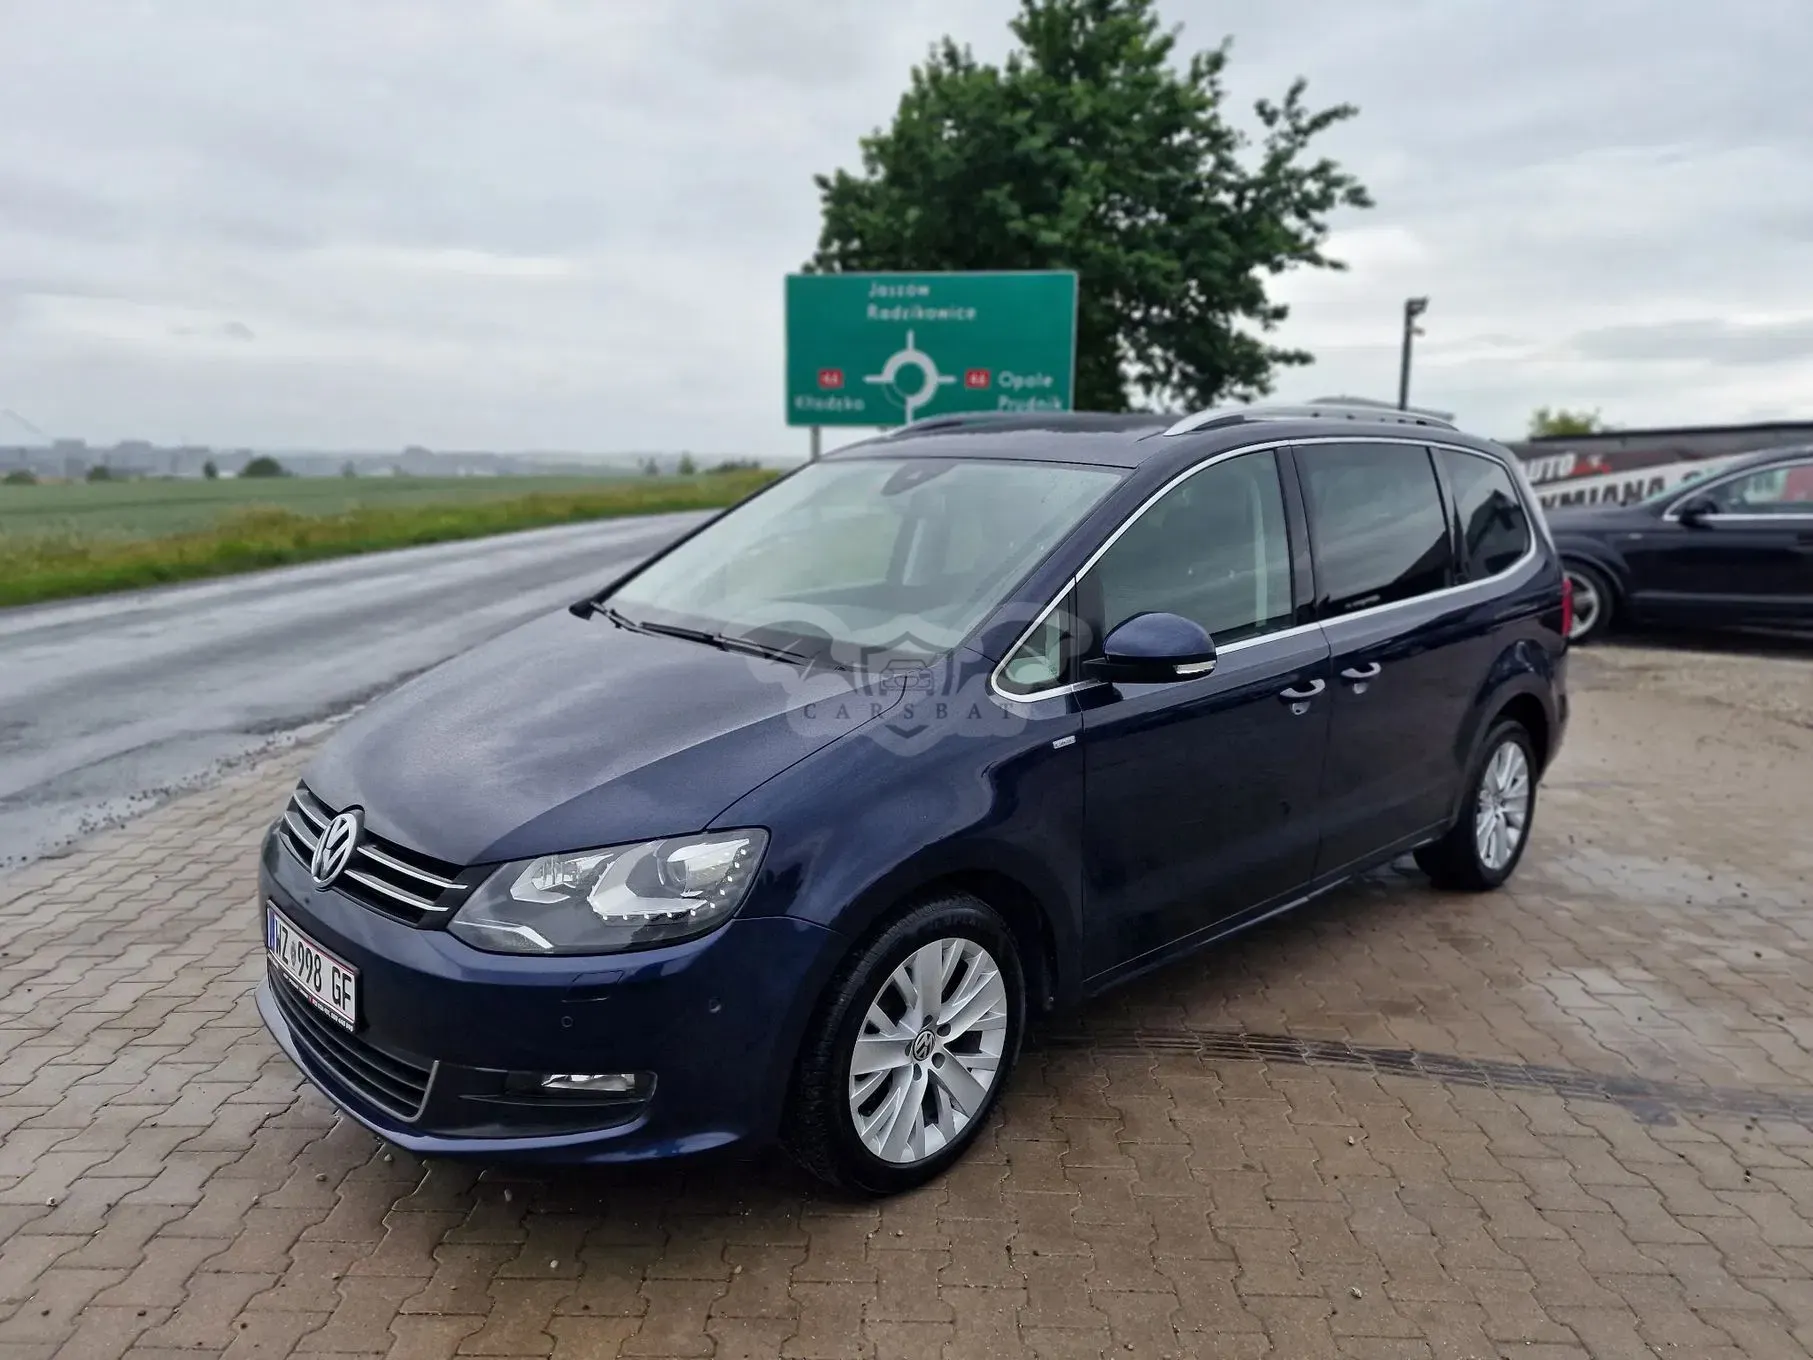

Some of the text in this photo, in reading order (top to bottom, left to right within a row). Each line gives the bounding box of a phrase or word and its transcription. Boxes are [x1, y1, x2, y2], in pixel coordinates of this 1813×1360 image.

[867, 304, 977, 321] Radzikowice
[998, 372, 1054, 391] Opole
[298, 941, 322, 993] 998
[332, 966, 352, 1011] GF
